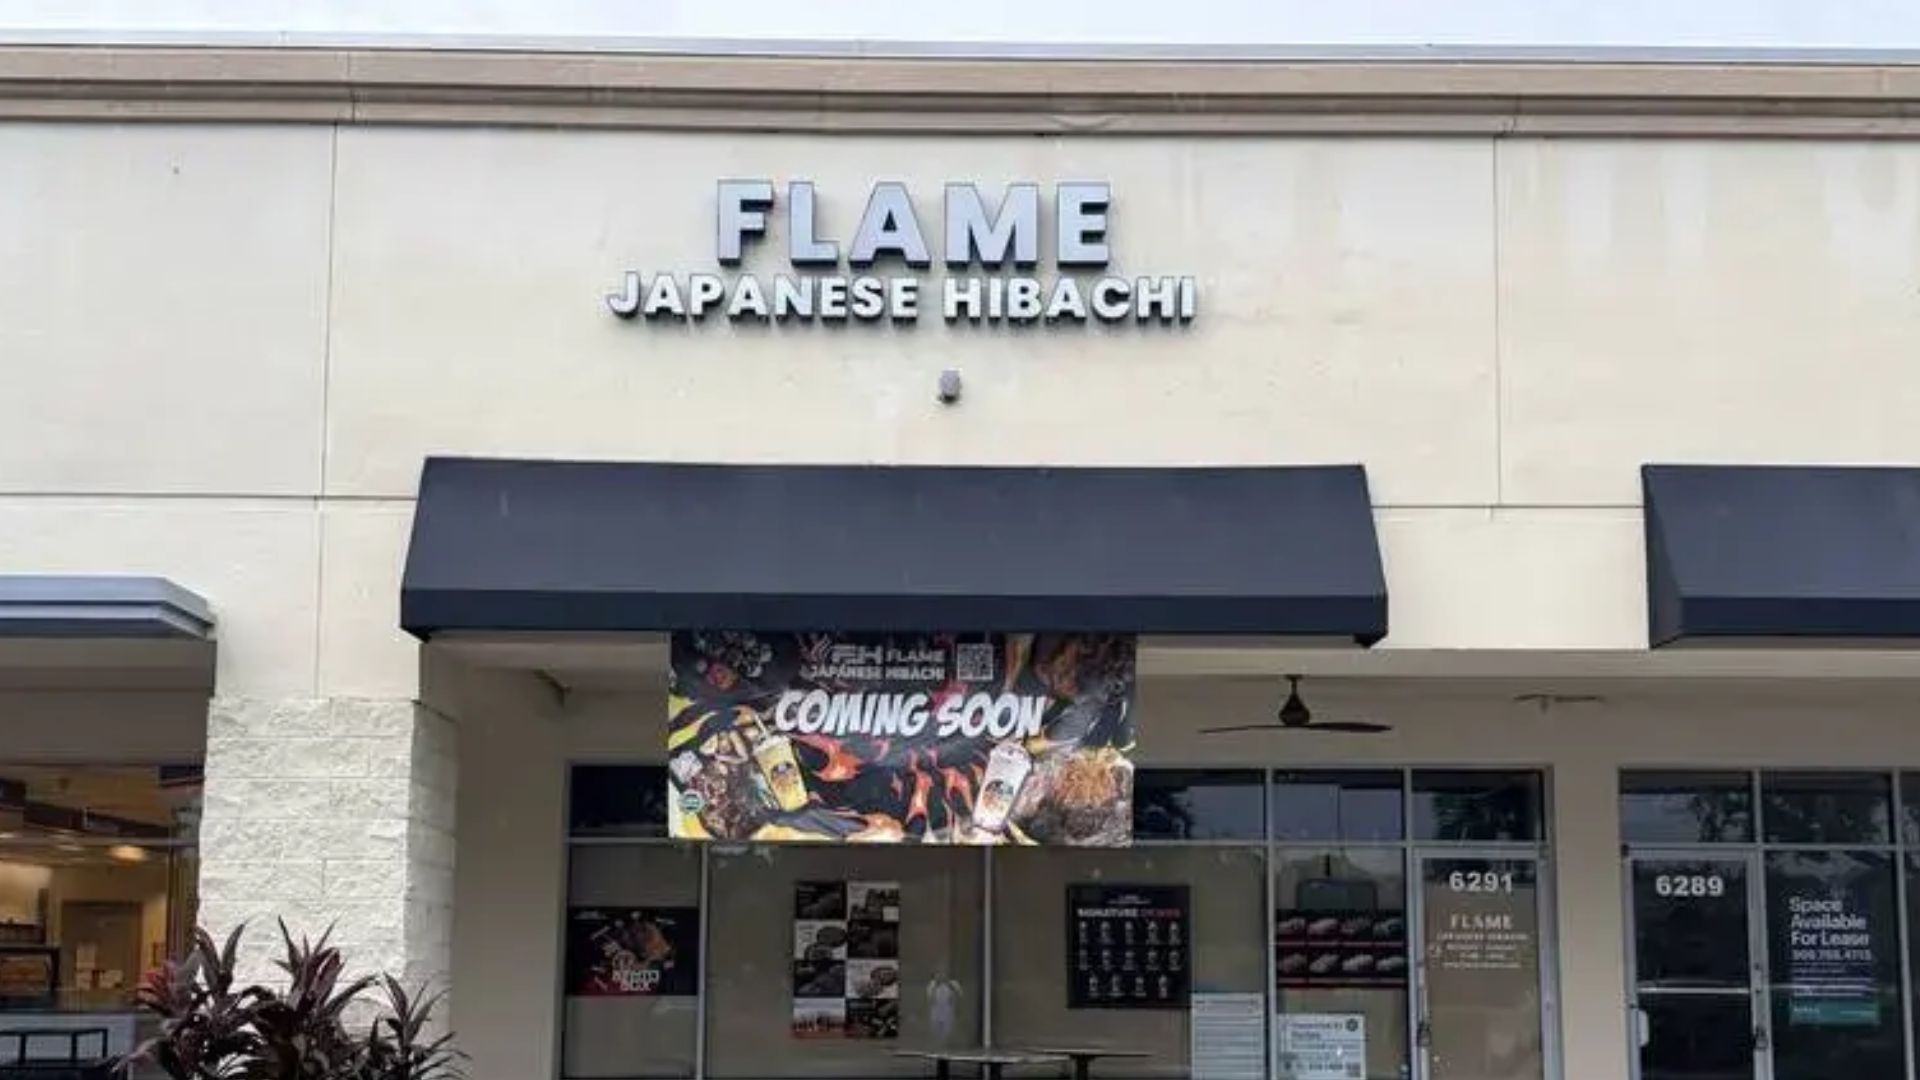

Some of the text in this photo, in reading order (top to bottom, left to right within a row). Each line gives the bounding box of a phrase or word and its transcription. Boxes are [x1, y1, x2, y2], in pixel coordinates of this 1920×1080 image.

[716, 179, 1111, 267] FLAME
[607, 271, 1197, 325] JAPANESE HIBACHI
[886, 649, 945, 663] FLAME
[809, 664, 945, 680] JAPANESE HIBACHI
[774, 689, 1045, 738] COMING SOON
[1450, 871, 1514, 892] 6291
[1655, 875, 1724, 896] 6289
[1788, 896, 1843, 914] Space
[1450, 914, 1513, 930] FLAME
[1790, 913, 1867, 930] Available
[1790, 930, 1870, 946] For Lease
